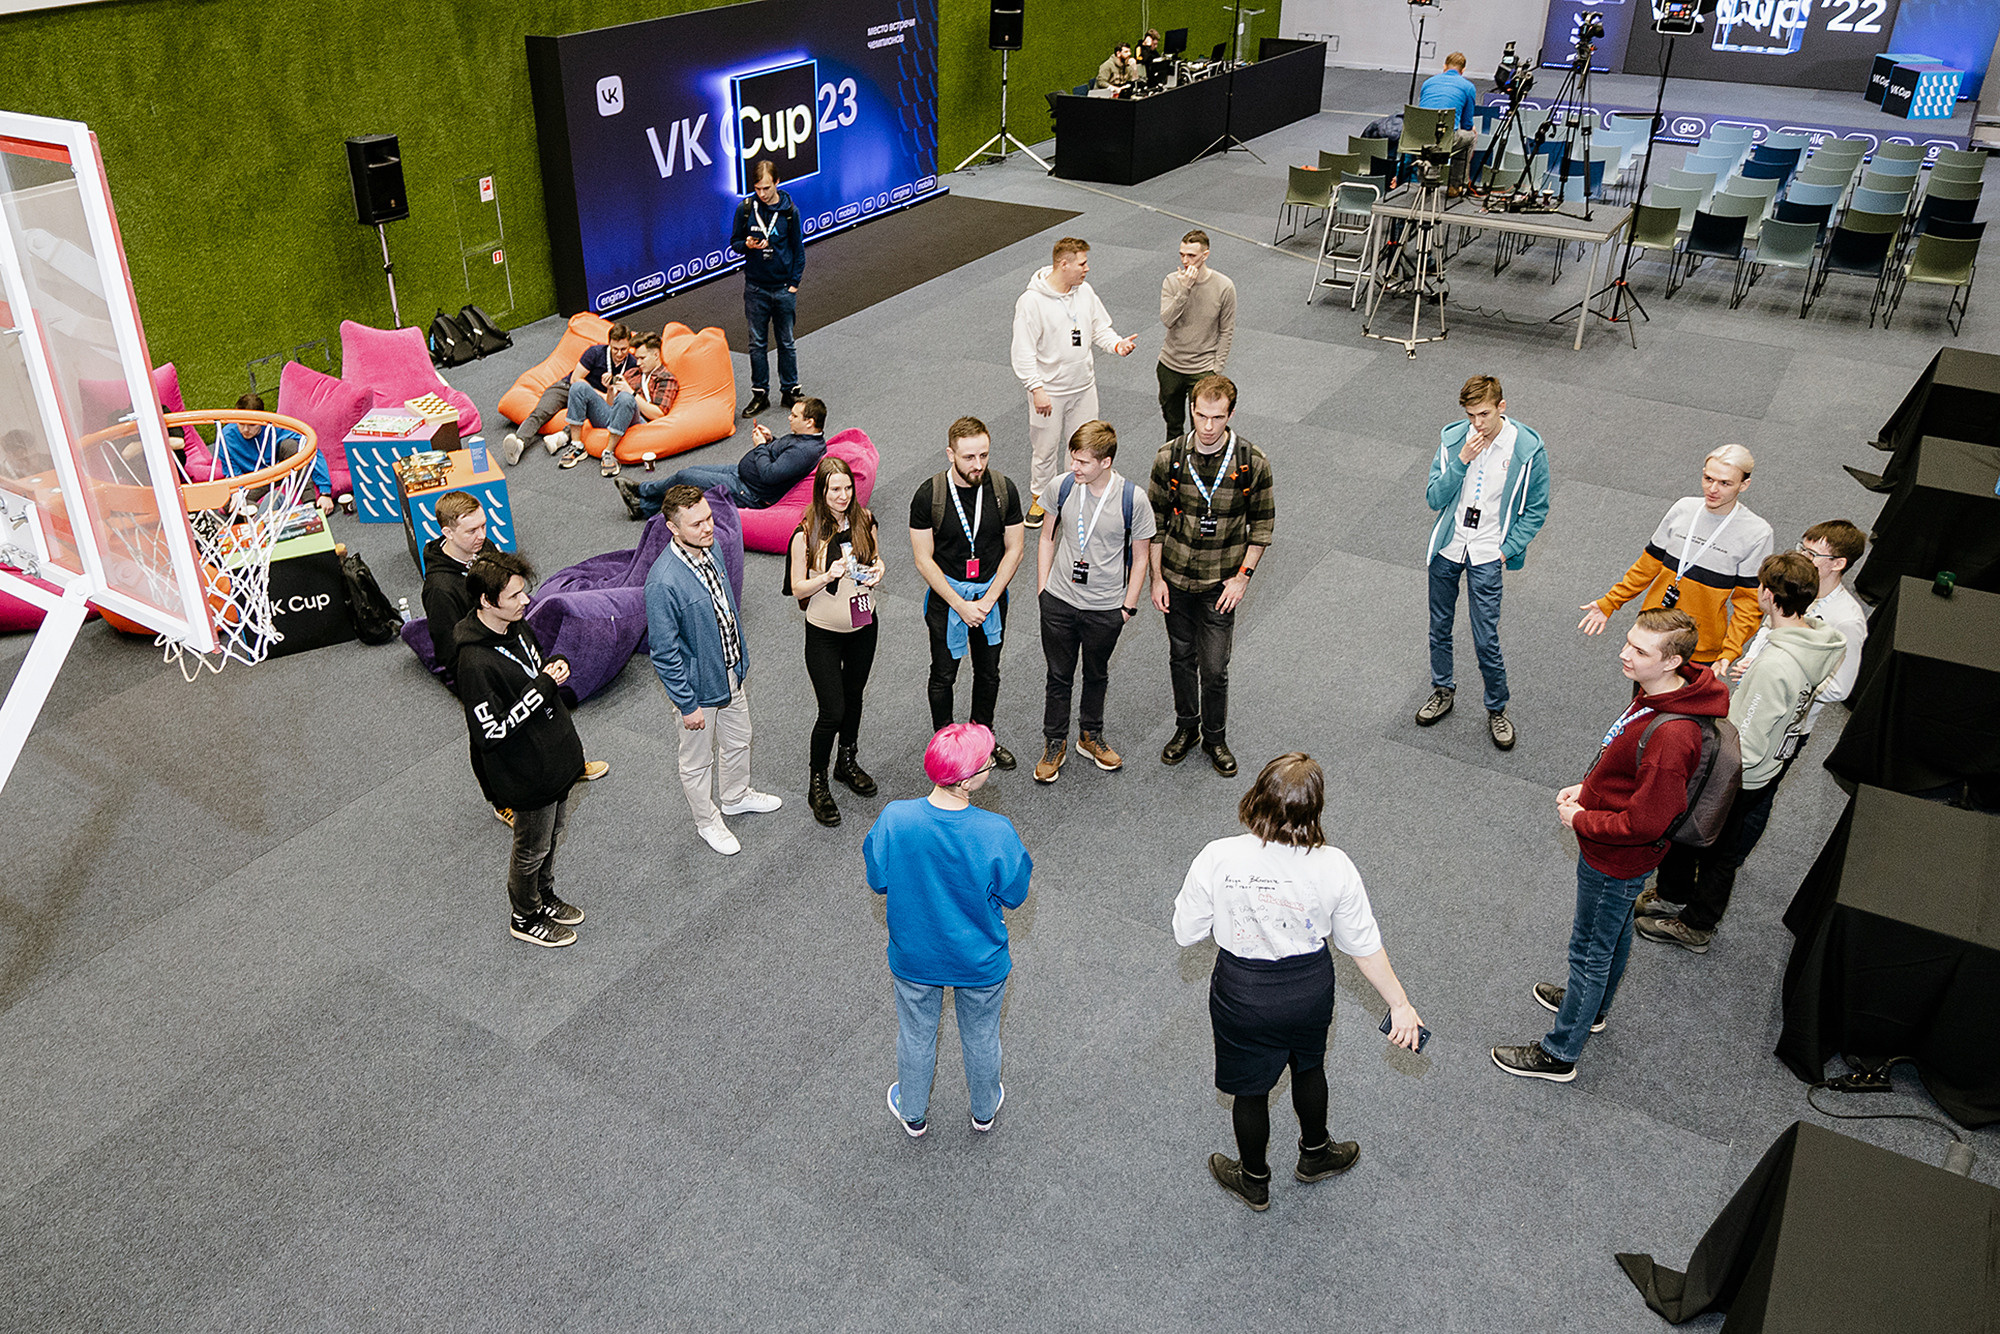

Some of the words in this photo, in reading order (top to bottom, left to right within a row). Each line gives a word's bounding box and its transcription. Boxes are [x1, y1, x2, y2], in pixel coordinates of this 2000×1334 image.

[601, 87, 619, 105] VK
[645, 113, 713, 179] VK
[720, 104, 813, 160] Cup
[817, 77, 858, 133] 23
[1679, 121, 1696, 133] go
[838, 205, 857, 218] mobile
[600, 289, 626, 306] engine
[637, 277, 662, 292] mobile
[709, 255, 719, 267] go
[288, 592, 331, 613] Cup
[1739, 692, 1762, 737] INNOPOLIS
